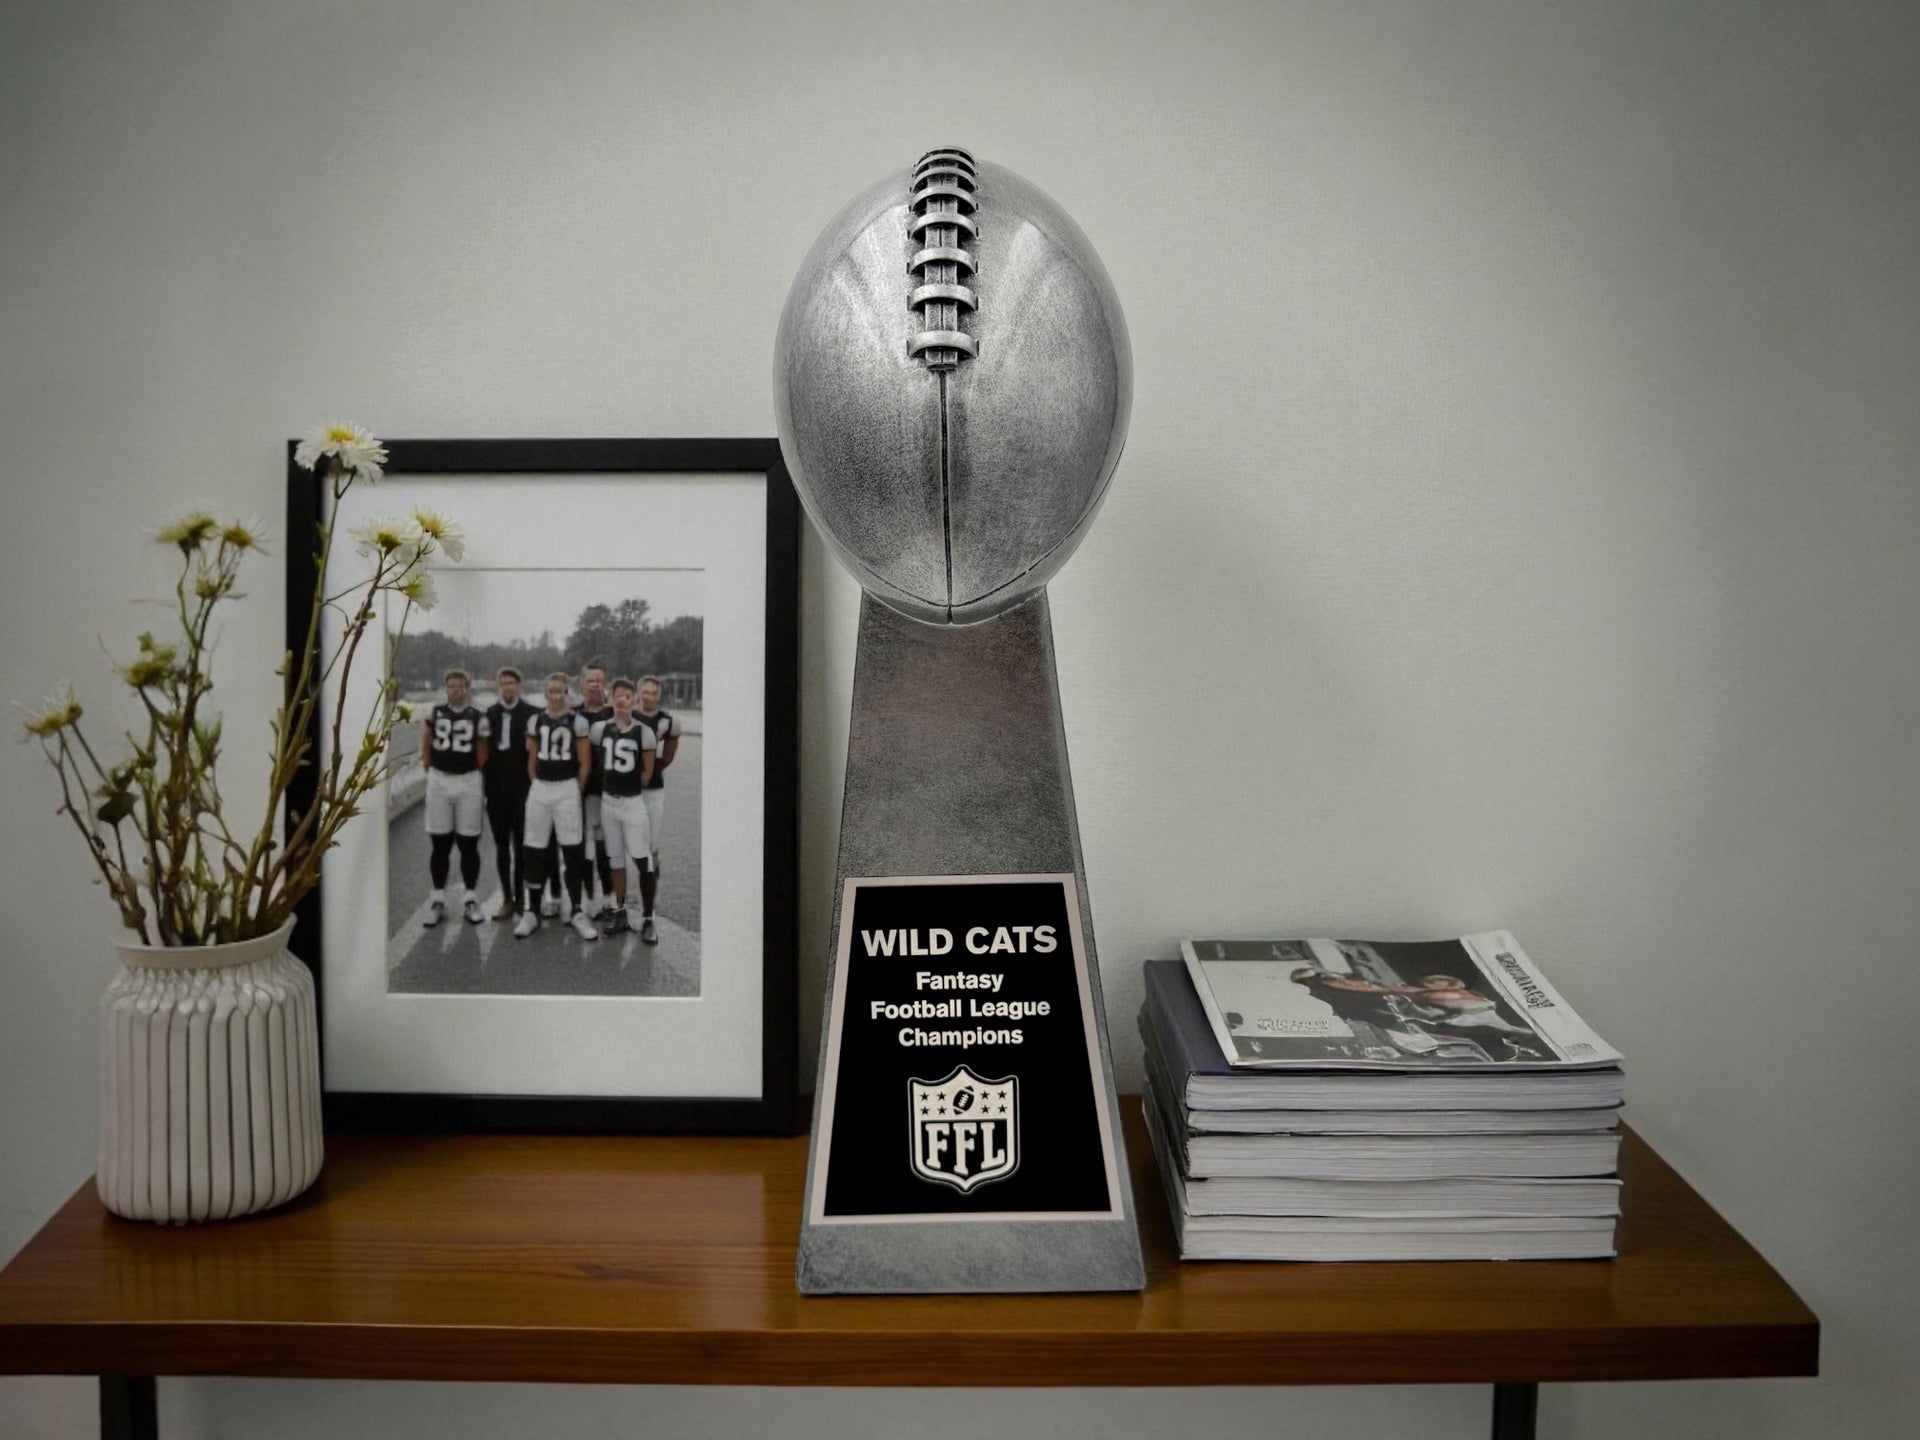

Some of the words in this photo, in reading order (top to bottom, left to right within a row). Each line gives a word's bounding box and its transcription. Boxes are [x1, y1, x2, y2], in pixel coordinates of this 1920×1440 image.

[601, 737, 638, 773] 15
[860, 927, 954, 957] WILD
[965, 925, 1058, 955] CATS
[916, 971, 1004, 992] Fantasy
[870, 999, 962, 1020] Football
[969, 998, 1051, 1020] League
[898, 1027, 1024, 1049] Champions
[924, 1121, 1006, 1176] FFL
